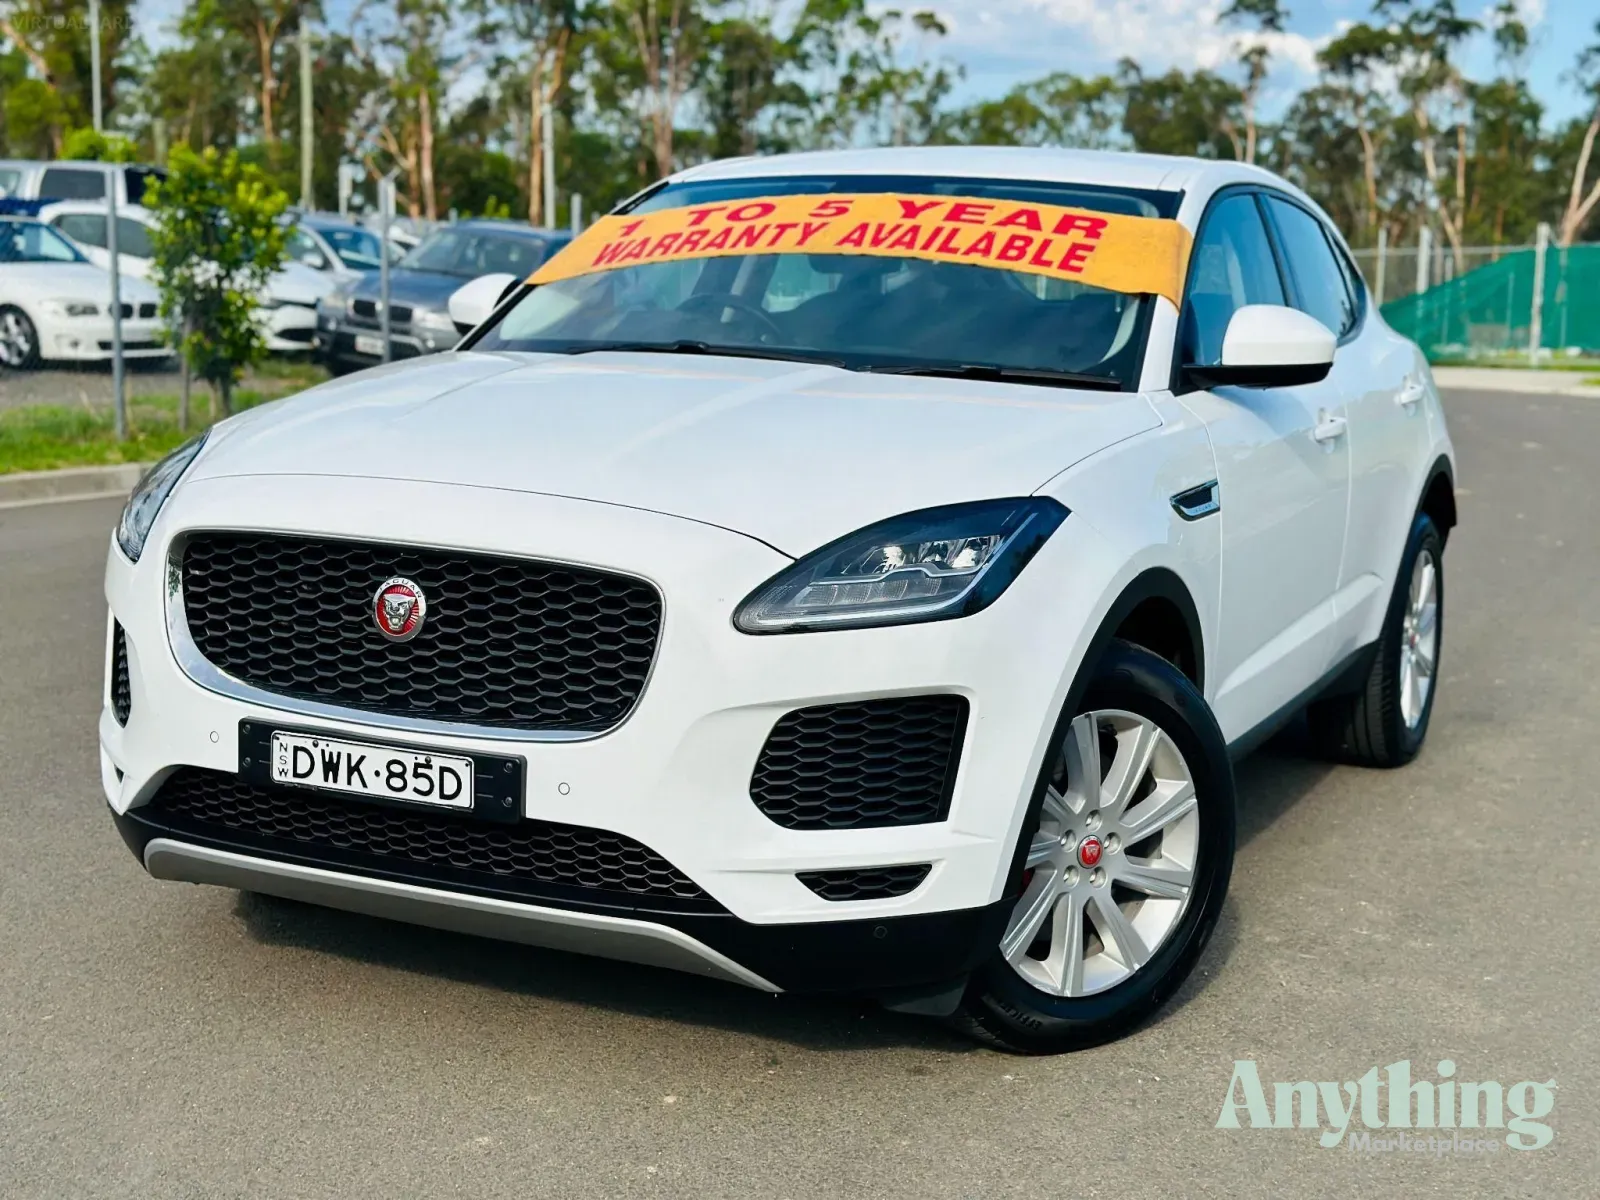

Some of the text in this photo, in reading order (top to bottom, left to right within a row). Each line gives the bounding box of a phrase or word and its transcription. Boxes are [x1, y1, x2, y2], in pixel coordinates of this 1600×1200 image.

[622, 199, 1108, 240] 1 TO 5 YEAR
[592, 222, 1097, 273] WARRANTY AVAILABLE
[278, 740, 289, 778] NSW
